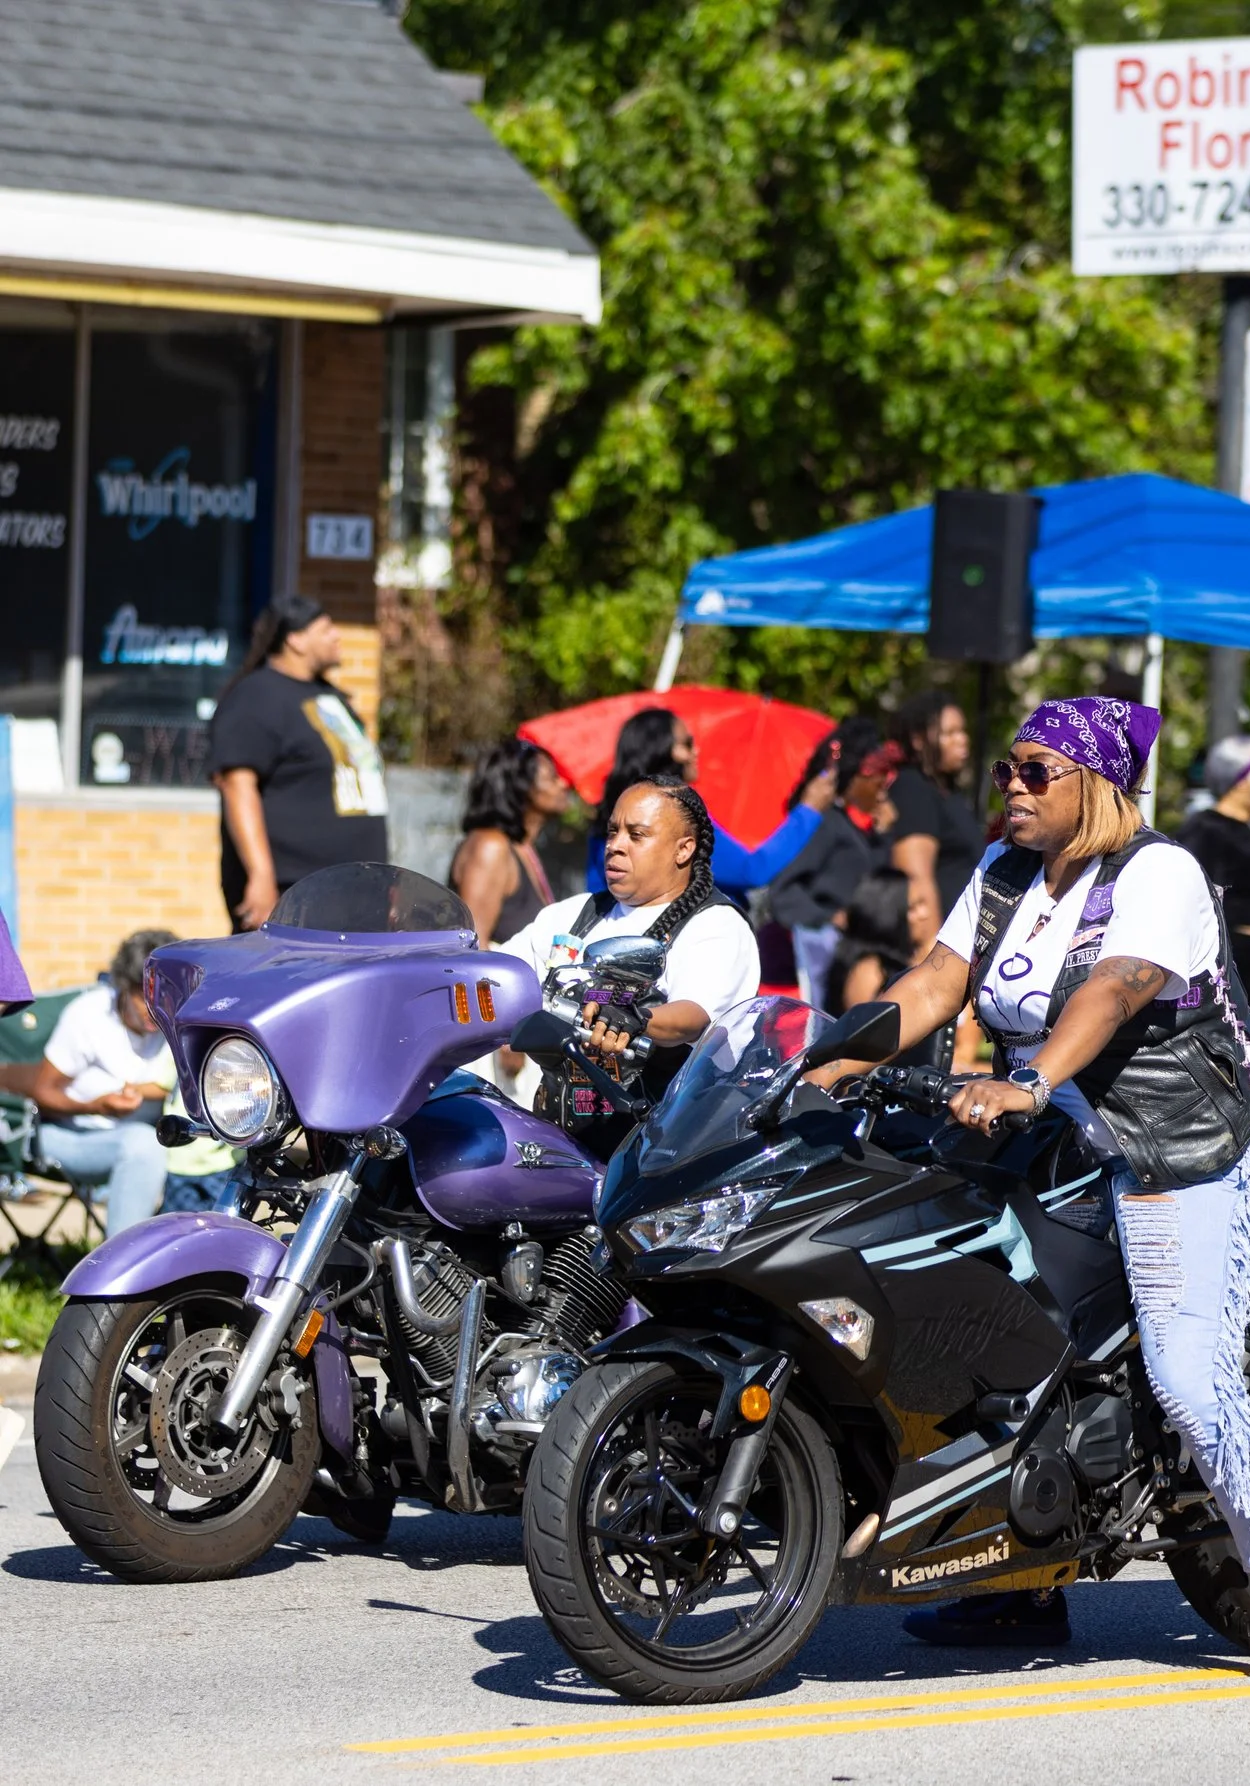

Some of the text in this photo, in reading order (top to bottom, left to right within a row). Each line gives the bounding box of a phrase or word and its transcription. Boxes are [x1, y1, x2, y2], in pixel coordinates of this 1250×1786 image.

[98, 470, 257, 529] Whirlpool
[314, 520, 366, 553] 734
[765, 1356, 788, 1390] ABS
[891, 1541, 1010, 1588] Kawasaki
